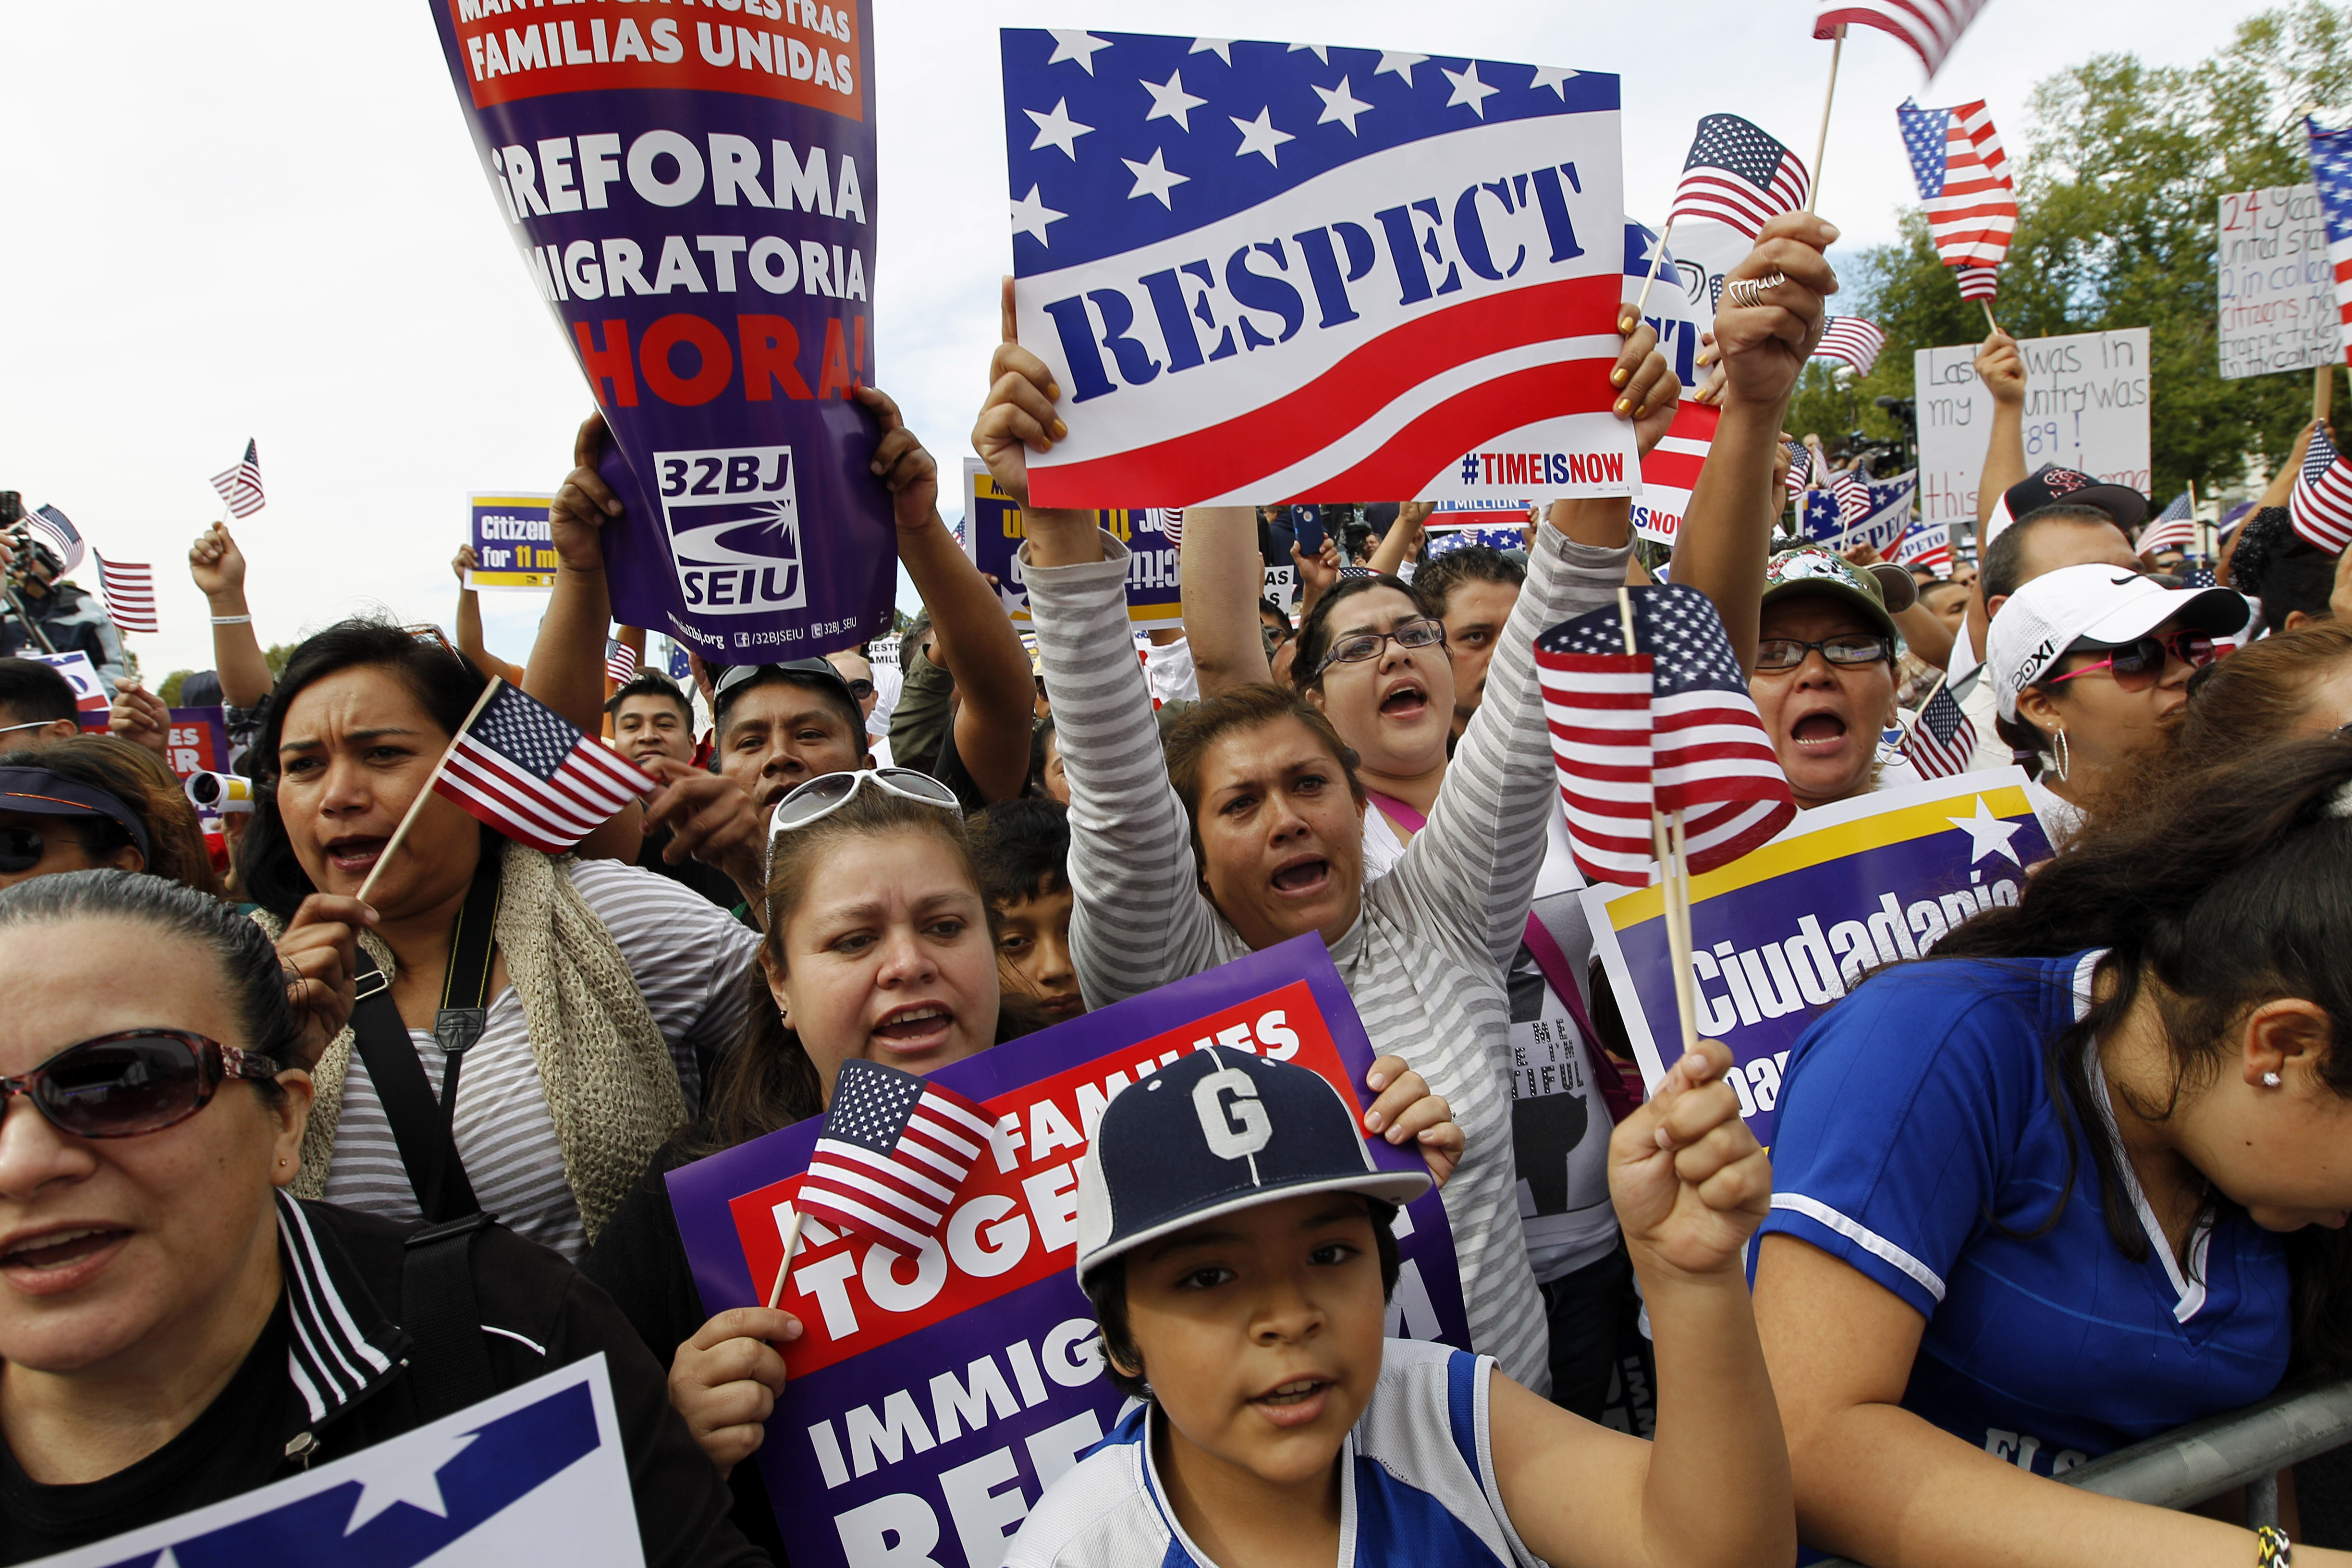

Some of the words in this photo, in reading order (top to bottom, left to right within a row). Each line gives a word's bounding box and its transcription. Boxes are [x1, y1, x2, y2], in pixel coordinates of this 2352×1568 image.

[467, 18, 684, 81] FAMILIAS
[696, 21, 854, 96] UNIDAS
[2223, 190, 2263, 232] 24
[524, 235, 867, 303] MIGRATORIA
[1042, 161, 1585, 404] RESPECT
[1928, 397, 1972, 426] my
[662, 453, 790, 498] 32BJ
[1461, 452, 1623, 485] #TIMEISNOW
[481, 546, 511, 568] for
[515, 545, 531, 568] 11
[684, 564, 799, 606] SEIU
[1532, 1018, 1568, 1044] ME
[1192, 1067, 1273, 1161] G
[793, 1156, 1087, 1341] TOGE
[833, 1396, 1146, 1568] REF
